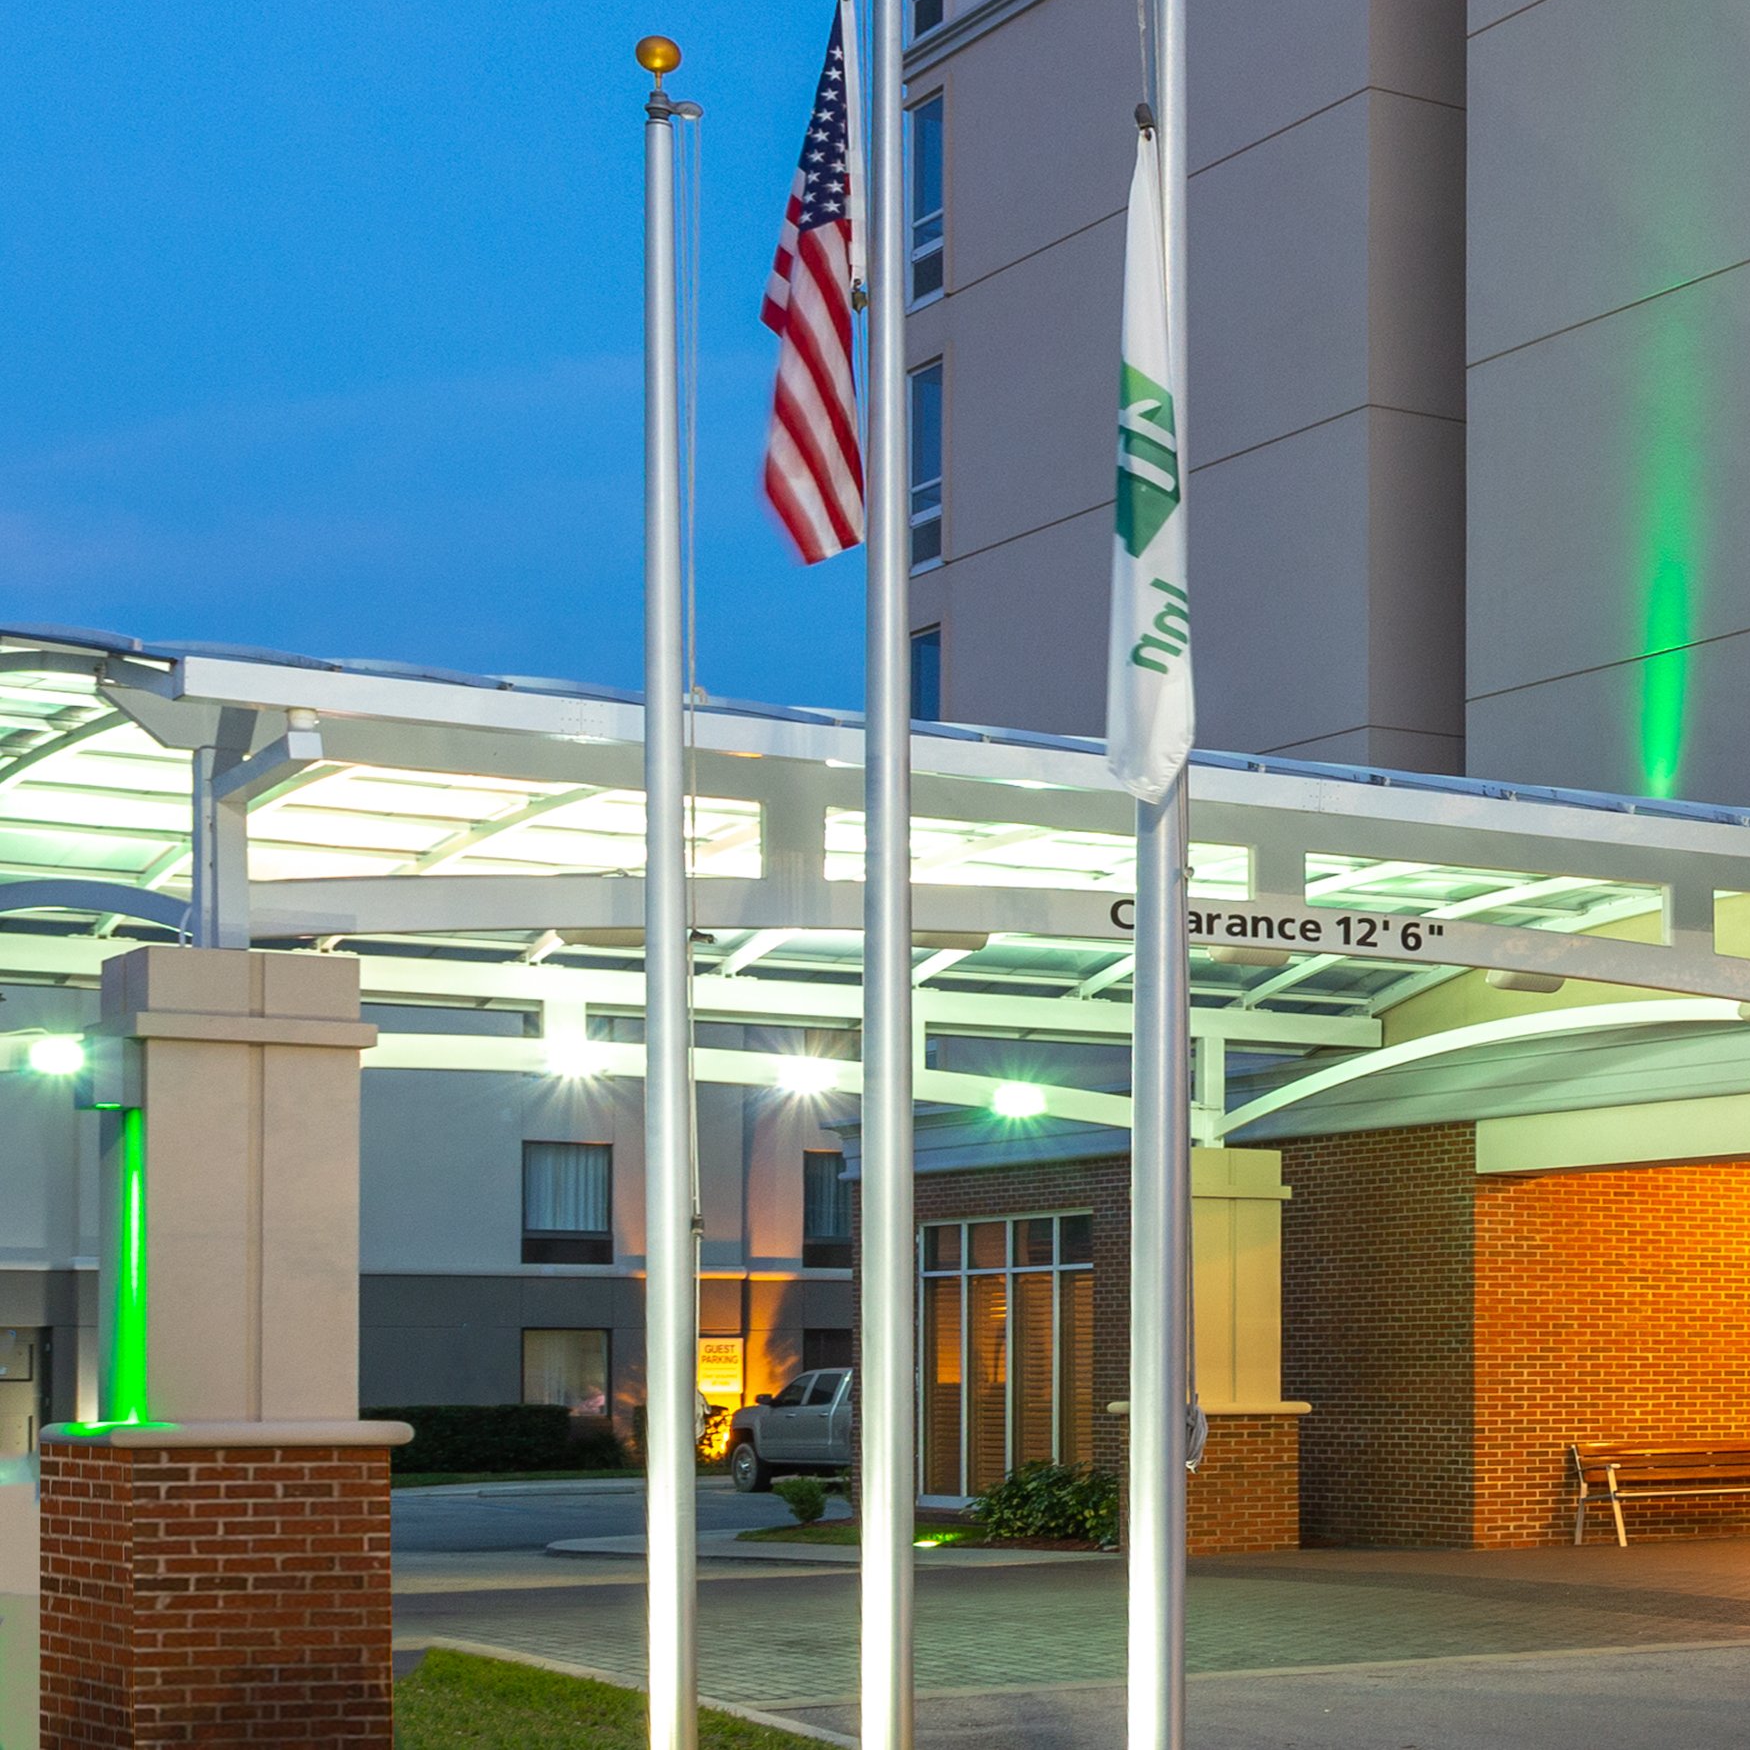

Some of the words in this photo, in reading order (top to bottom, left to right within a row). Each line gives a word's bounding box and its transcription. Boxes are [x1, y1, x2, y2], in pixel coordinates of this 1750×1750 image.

[1110, 900, 1323, 943] Carance
[704, 1344, 735, 1354] GUEST
[701, 1355, 739, 1364] PARKING
